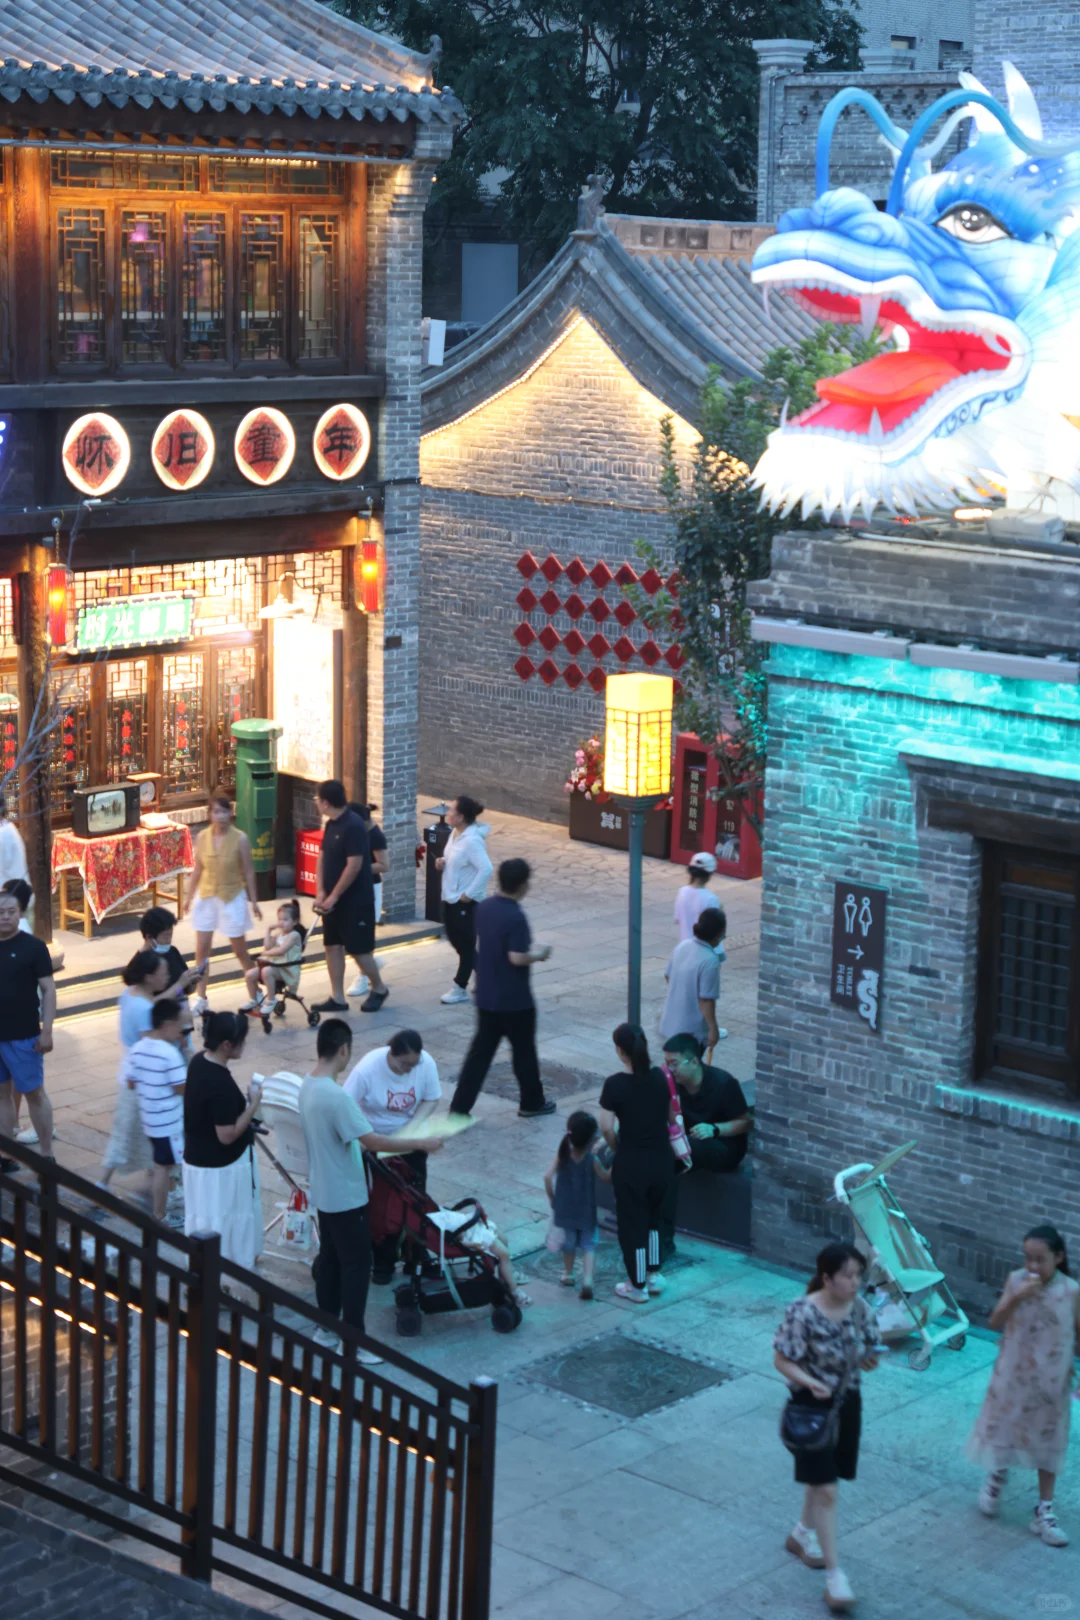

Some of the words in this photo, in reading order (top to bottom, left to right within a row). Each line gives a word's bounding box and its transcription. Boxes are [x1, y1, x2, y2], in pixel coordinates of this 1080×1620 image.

[76, 423, 356, 475] 怀旧童年
[687, 770, 700, 832] 微型消防站
[723, 820, 735, 832] 119
